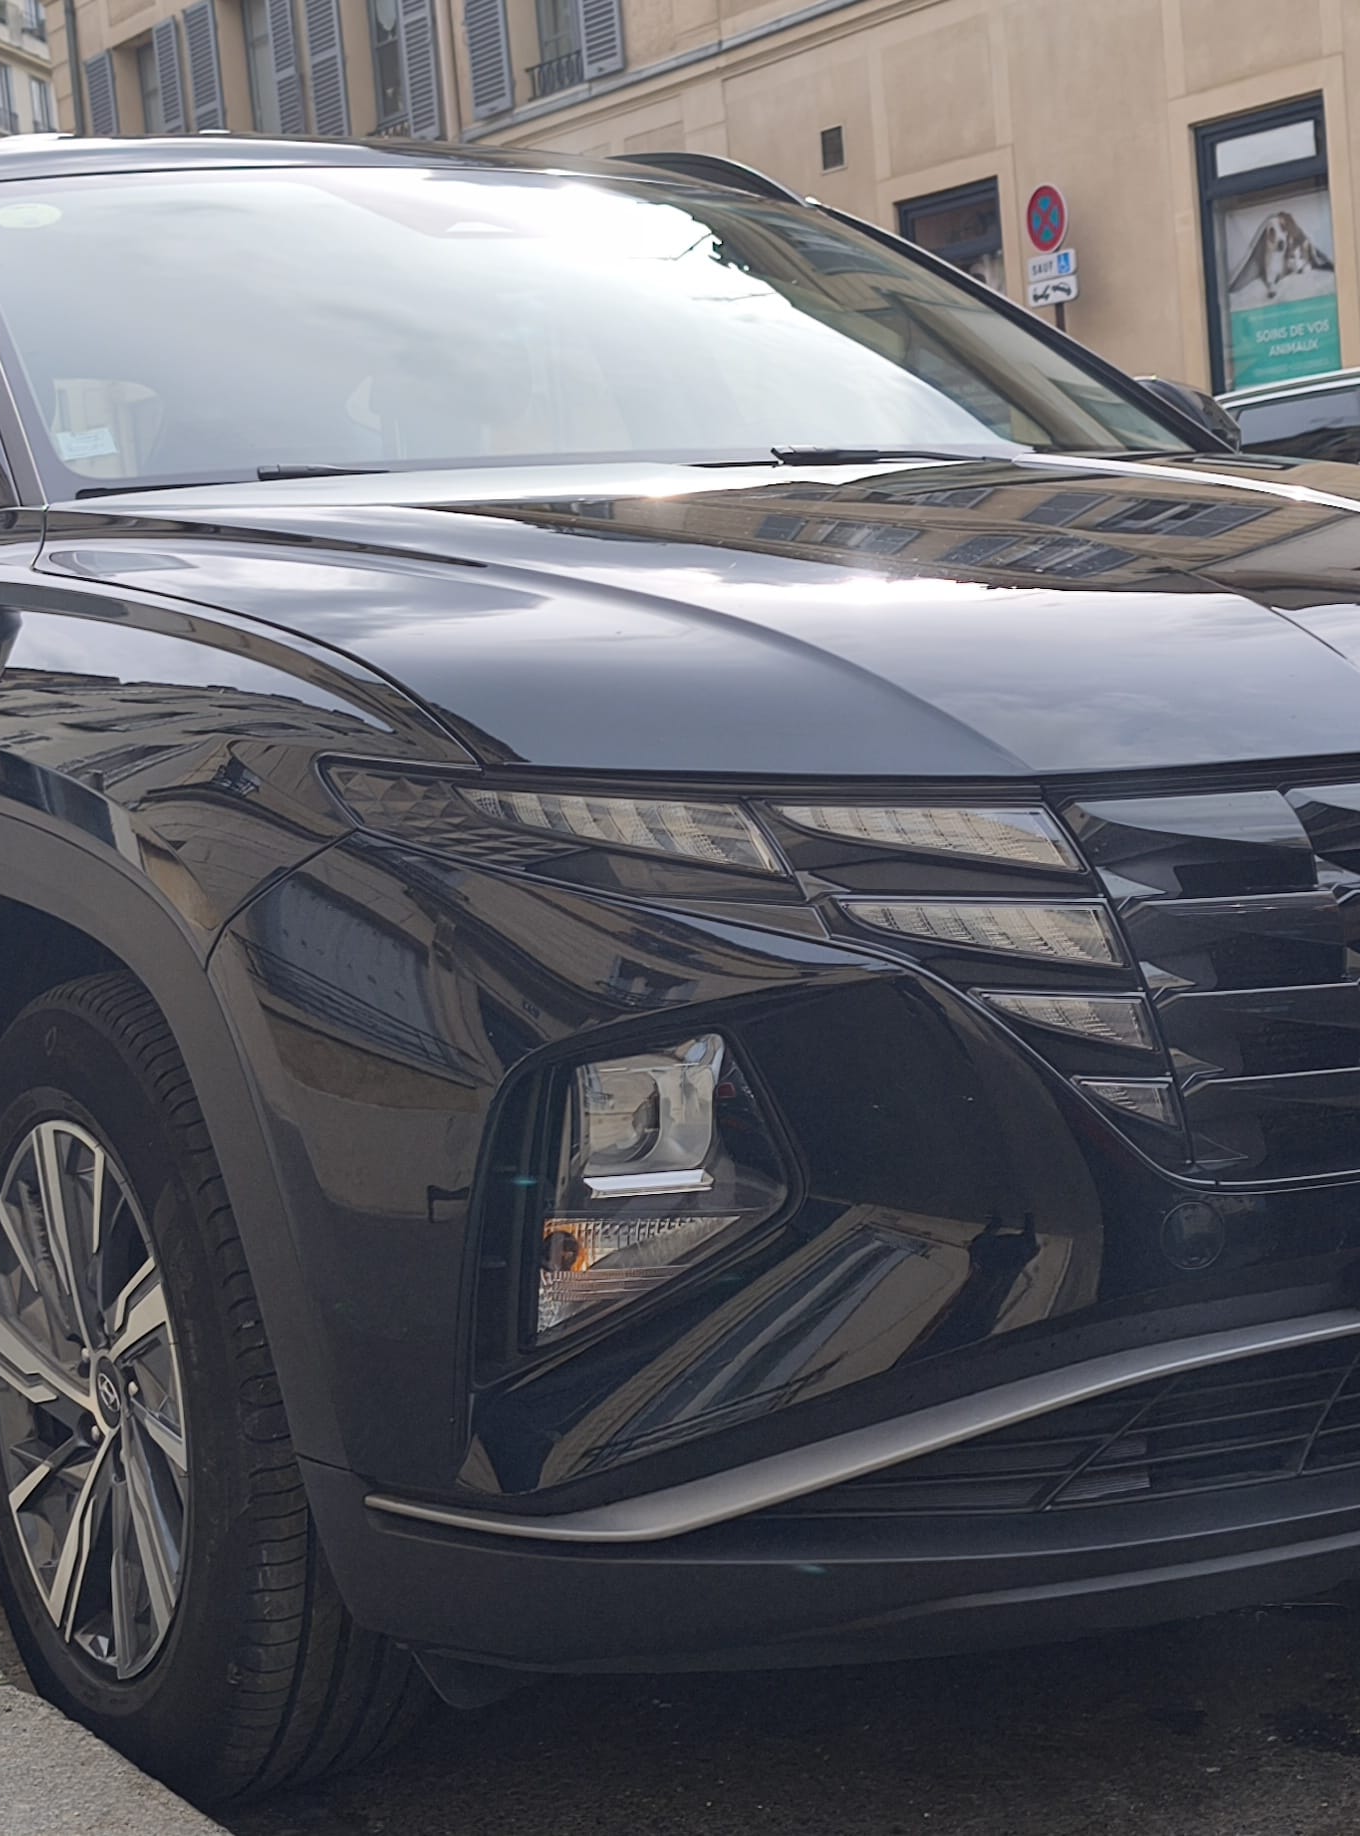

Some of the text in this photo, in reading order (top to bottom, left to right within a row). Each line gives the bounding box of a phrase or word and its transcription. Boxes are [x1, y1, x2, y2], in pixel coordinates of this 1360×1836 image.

[1256, 319, 1329, 343] SOINS DE VOS
[1269, 338, 1319, 357] ANIMAUX
